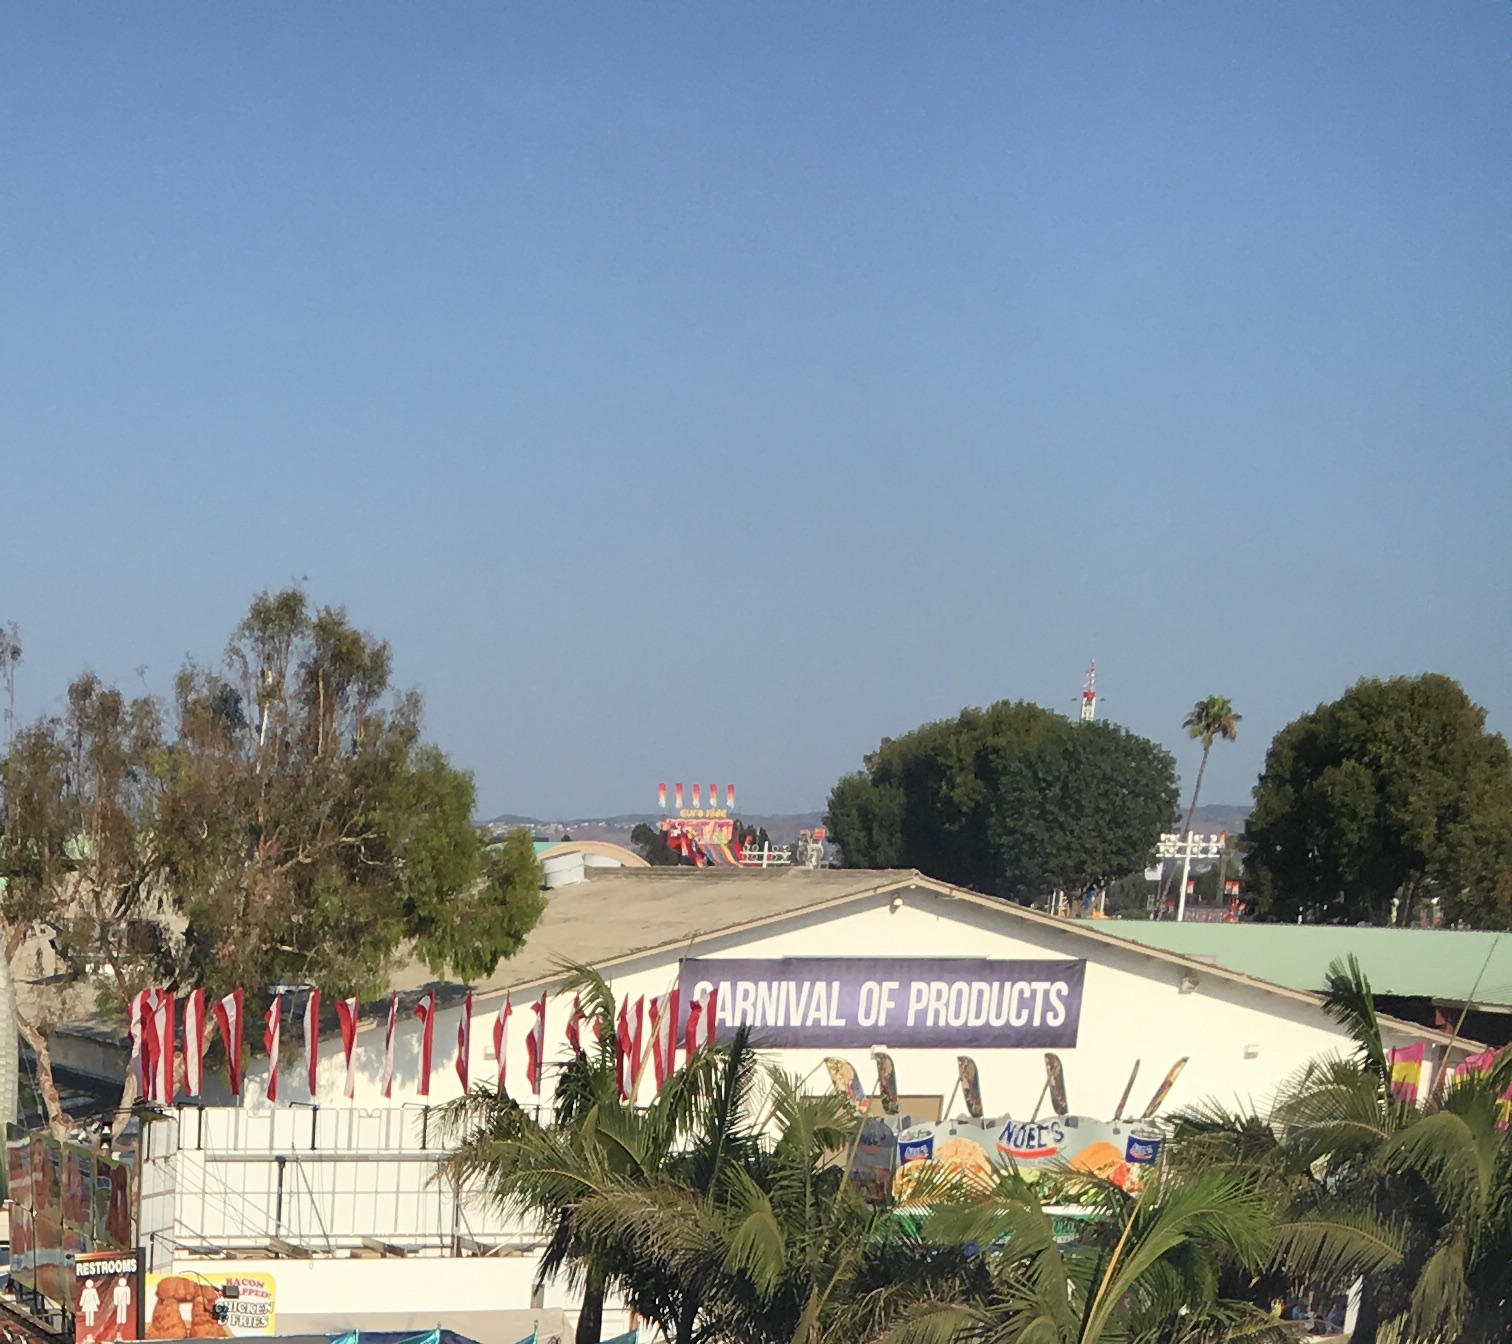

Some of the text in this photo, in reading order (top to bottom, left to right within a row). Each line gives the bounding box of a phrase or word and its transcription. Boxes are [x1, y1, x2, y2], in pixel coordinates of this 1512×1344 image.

[857, 981, 899, 1027] OF
[906, 981, 1068, 1027] PRODUCTS
[76, 1258, 137, 1276] RESTROOMS
[225, 1277, 265, 1289] BACON
[217, 1284, 272, 1299] APPED!
[230, 1314, 269, 1328] FRIES
